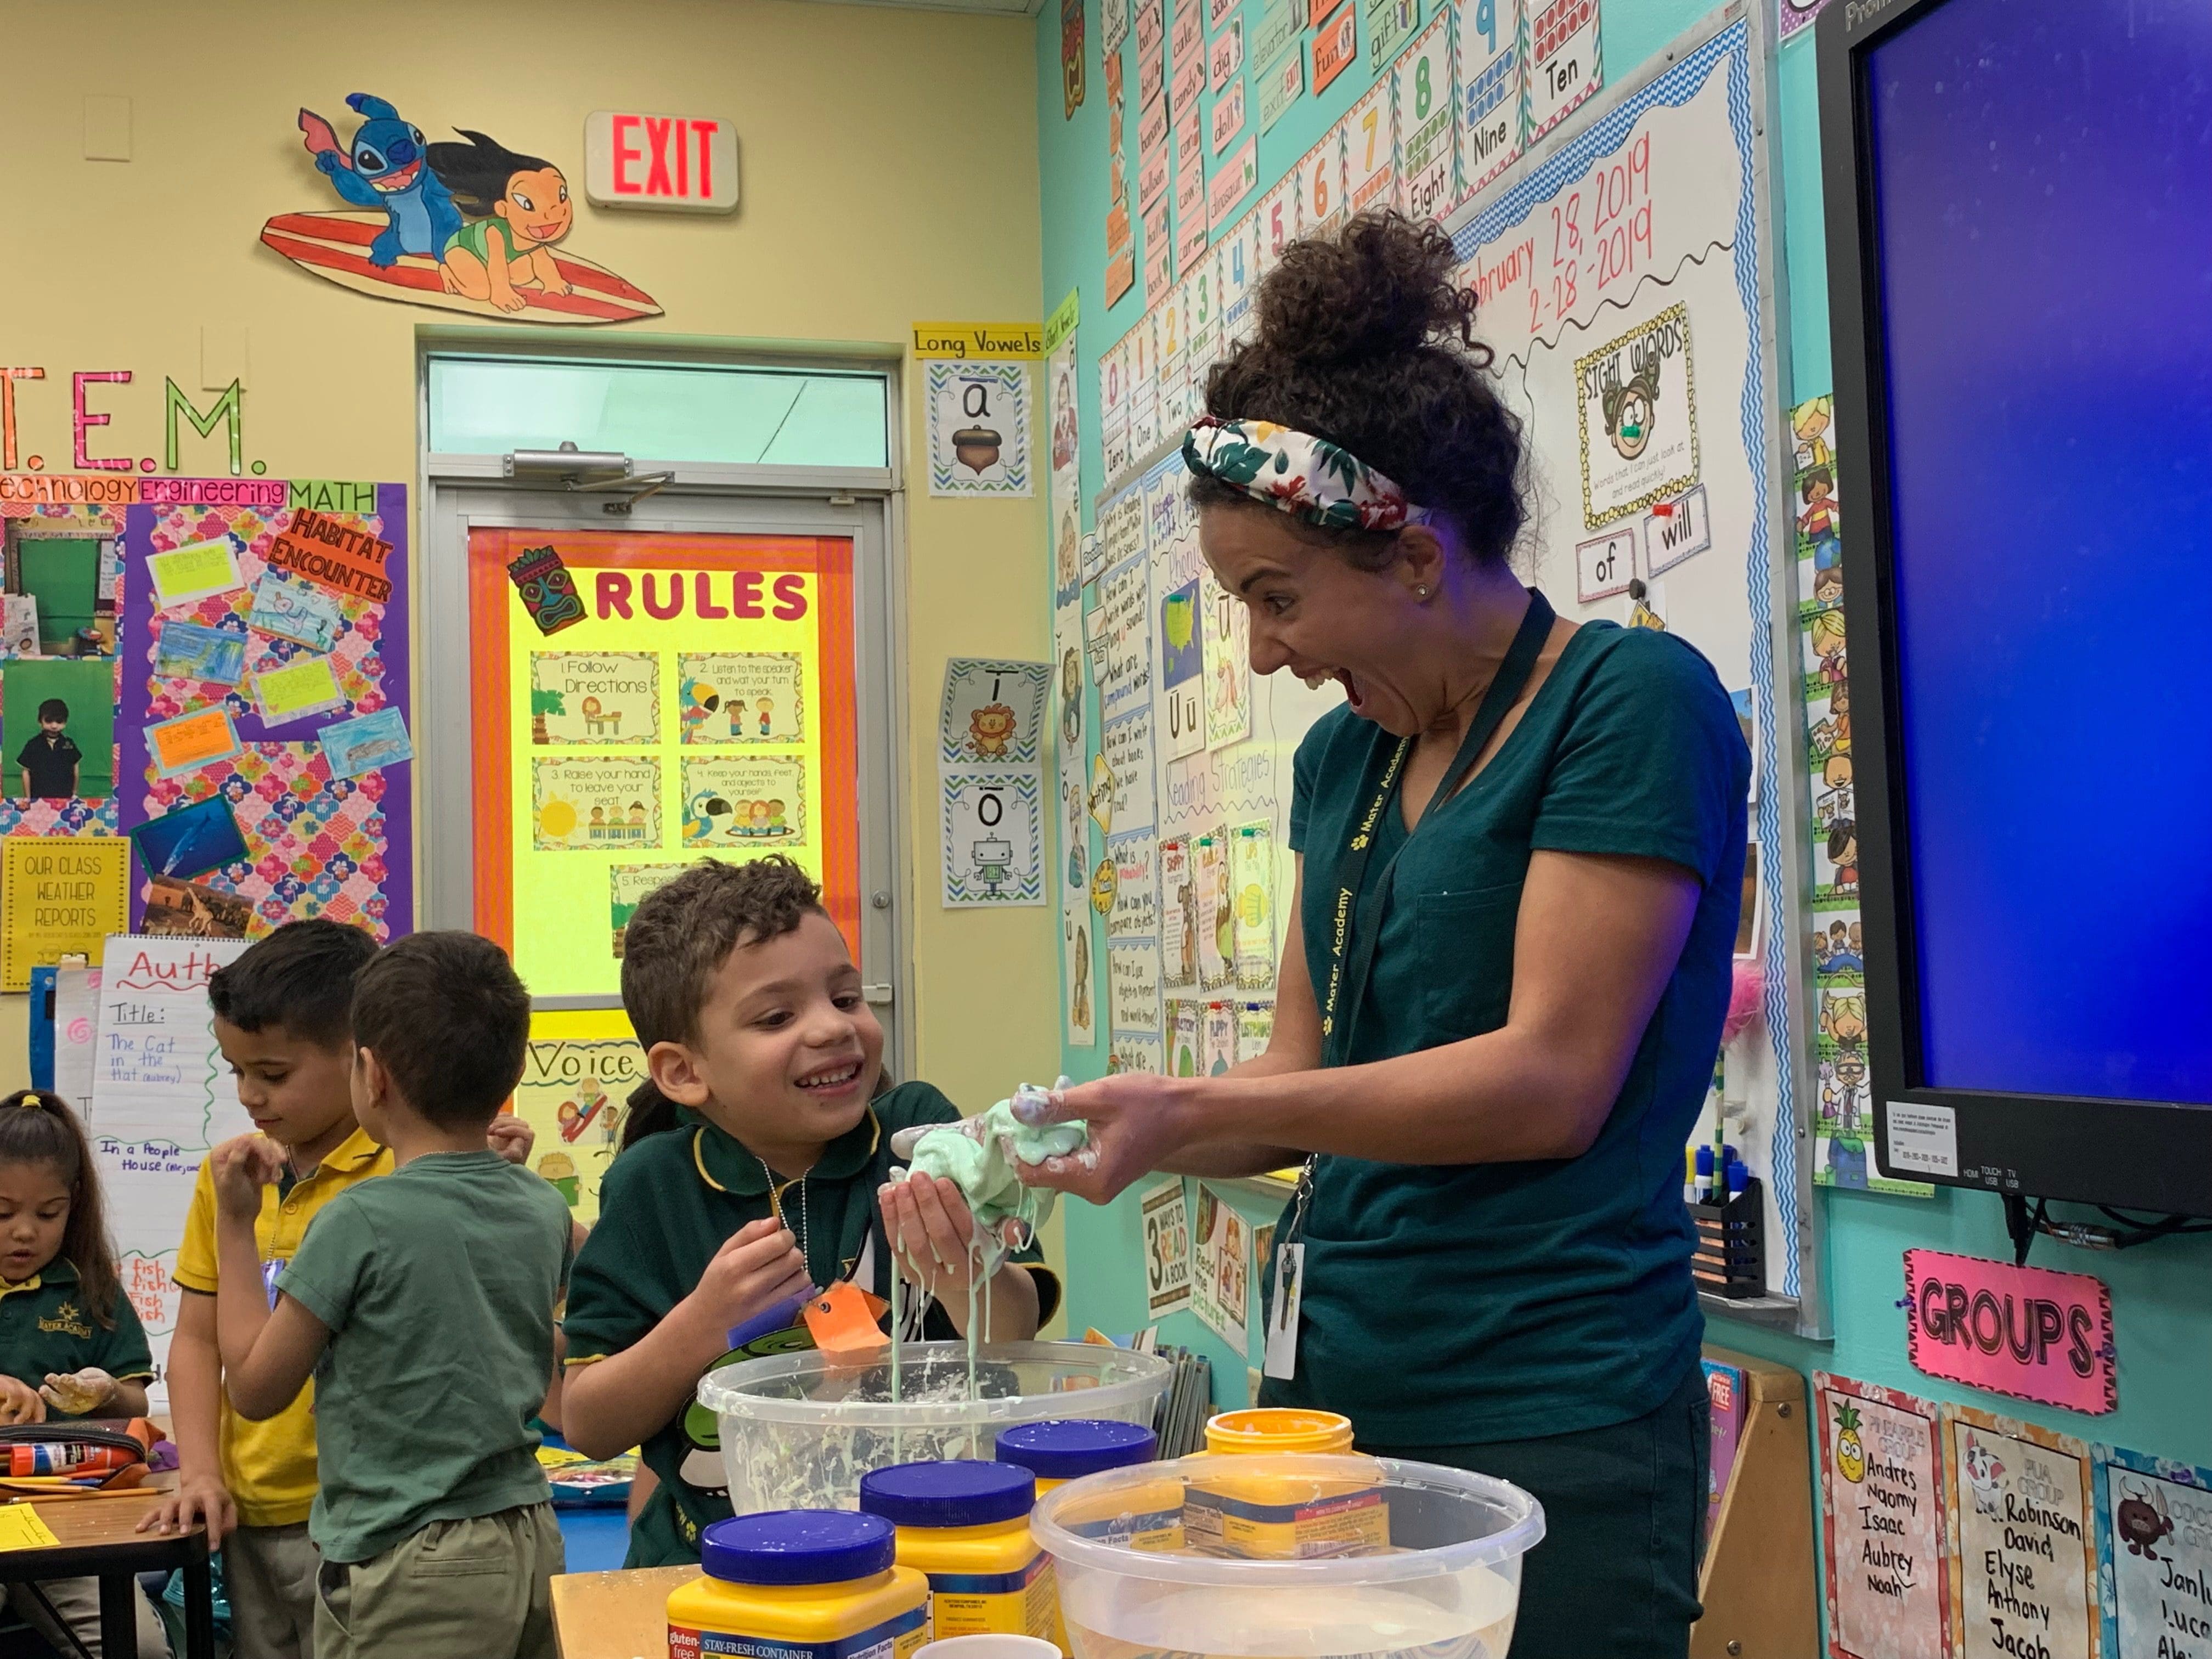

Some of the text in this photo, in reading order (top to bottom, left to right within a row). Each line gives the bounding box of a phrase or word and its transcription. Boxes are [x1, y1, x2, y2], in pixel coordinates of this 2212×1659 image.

[1173, 22, 1192, 58] cake
[1372, 8, 1398, 69] gift
[1476, 0, 1497, 54] 9
[1253, 21, 1289, 71] elevator
[1316, 44, 1338, 78] fun
[1214, 50, 1230, 78] dig
[1286, 62, 1299, 92] EXIT
[1174, 69, 1197, 112] candy
[1415, 57, 1432, 120] 8
[1546, 59, 1578, 100] Ten
[1263, 75, 1285, 121] exit
[1215, 103, 1233, 143] doll
[1180, 134, 1194, 159] can
[1362, 106, 1378, 172] 7
[1474, 121, 1506, 165] Nine
[612, 115, 718, 199] EXIT
[1179, 185, 1194, 210] cow
[1211, 174, 1243, 219] dinosaur
[1314, 157, 1328, 218] 6
[1410, 165, 1446, 218] Eight
[1594, 131, 1650, 235] 2019
[1271, 200, 1284, 257] 5
[1179, 239, 1193, 263] car
[1232, 239, 1245, 289] 4
[1198, 274, 1208, 324] 3
[915, 330, 1041, 358] Long Vowels
[1165, 307, 1177, 357] 2
[1584, 317, 1683, 400] SIGHT WORDS
[1108, 363, 1118, 406] 0
[1166, 399, 1182, 424] Two
[1137, 425, 1151, 448] One
[1108, 448, 1125, 473] Zero
[1594, 441, 1685, 490] Words that can just look at
[141, 481, 285, 504] Engineering
[290, 483, 375, 511] MATH
[1612, 487, 1623, 499] and
[1624, 479, 1640, 492] read
[291, 509, 393, 564] HABITAT
[1595, 500, 1692, 582] of will
[269, 538, 392, 603] ENCOUNTER
[596, 572, 808, 620] RULES
[1118, 578, 1127, 594] can
[568, 661, 618, 673] Follow
[712, 664, 736, 674] Listen
[737, 665, 747, 674] to
[748, 664, 761, 674] the
[763, 664, 793, 675] speaker
[716, 675, 789, 687] and wait your turn
[566, 679, 647, 693] Directions
[1118, 732, 1126, 745] can
[564, 769, 650, 783] Raise your hand
[729, 770, 747, 779] your
[1210, 747, 1269, 793] Strategies
[1360, 736, 1409, 833] Mater Academy
[571, 783, 644, 794] to leave your
[25, 856, 101, 874] OUR CLASS
[37, 882, 94, 900] WEATHER
[35, 908, 95, 926] REPORTS
[1325, 887, 1353, 1012] Mater Academy
[109, 1002, 165, 1023] Title:
[106, 1034, 175, 1053] The Cat
[111, 1053, 162, 1066] in the
[111, 1067, 138, 1081] Hat
[528, 1041, 634, 1077] Voice
[100, 1141, 180, 1159] In a People
[122, 1160, 161, 1171] House
[1980, 1165, 2002, 1176] TOUCH
[2007, 1169, 2017, 1178] TV
[1985, 1177, 1998, 1186] USB
[2006, 1179, 2019, 1189] USB
[1148, 1204, 1183, 1291] 3 WAYS TO
[1161, 1226, 1187, 1265] READ
[1165, 1261, 1188, 1286] A BOOK
[1197, 1248, 1215, 1279] Read
[1195, 1268, 1207, 1292] the
[1919, 1277, 2095, 1379] GROUPS
[1712, 1381, 1730, 1406] FREE
[1867, 1452, 1917, 1491] Andres
[2024, 1458, 2052, 1484] PUA
[1867, 1483, 1917, 1517] Naomy
[2017, 1476, 2064, 1506] GROUP
[1859, 1505, 1905, 1536] Isaac
[2005, 1492, 2081, 1541] Robinson
[1863, 1539, 1913, 1578] Aubrey
[2004, 1527, 2054, 1562] David
[1985, 1549, 2034, 1590] Elyse
[1867, 1574, 1903, 1599] Noah
[1988, 1578, 2050, 1630] Anthony
[669, 1631, 700, 1646] gluten-
[673, 1645, 695, 1659] free
[704, 1639, 813, 1659] STAY-FRESH CONTAINER
[877, 1640, 893, 1653] Facts
